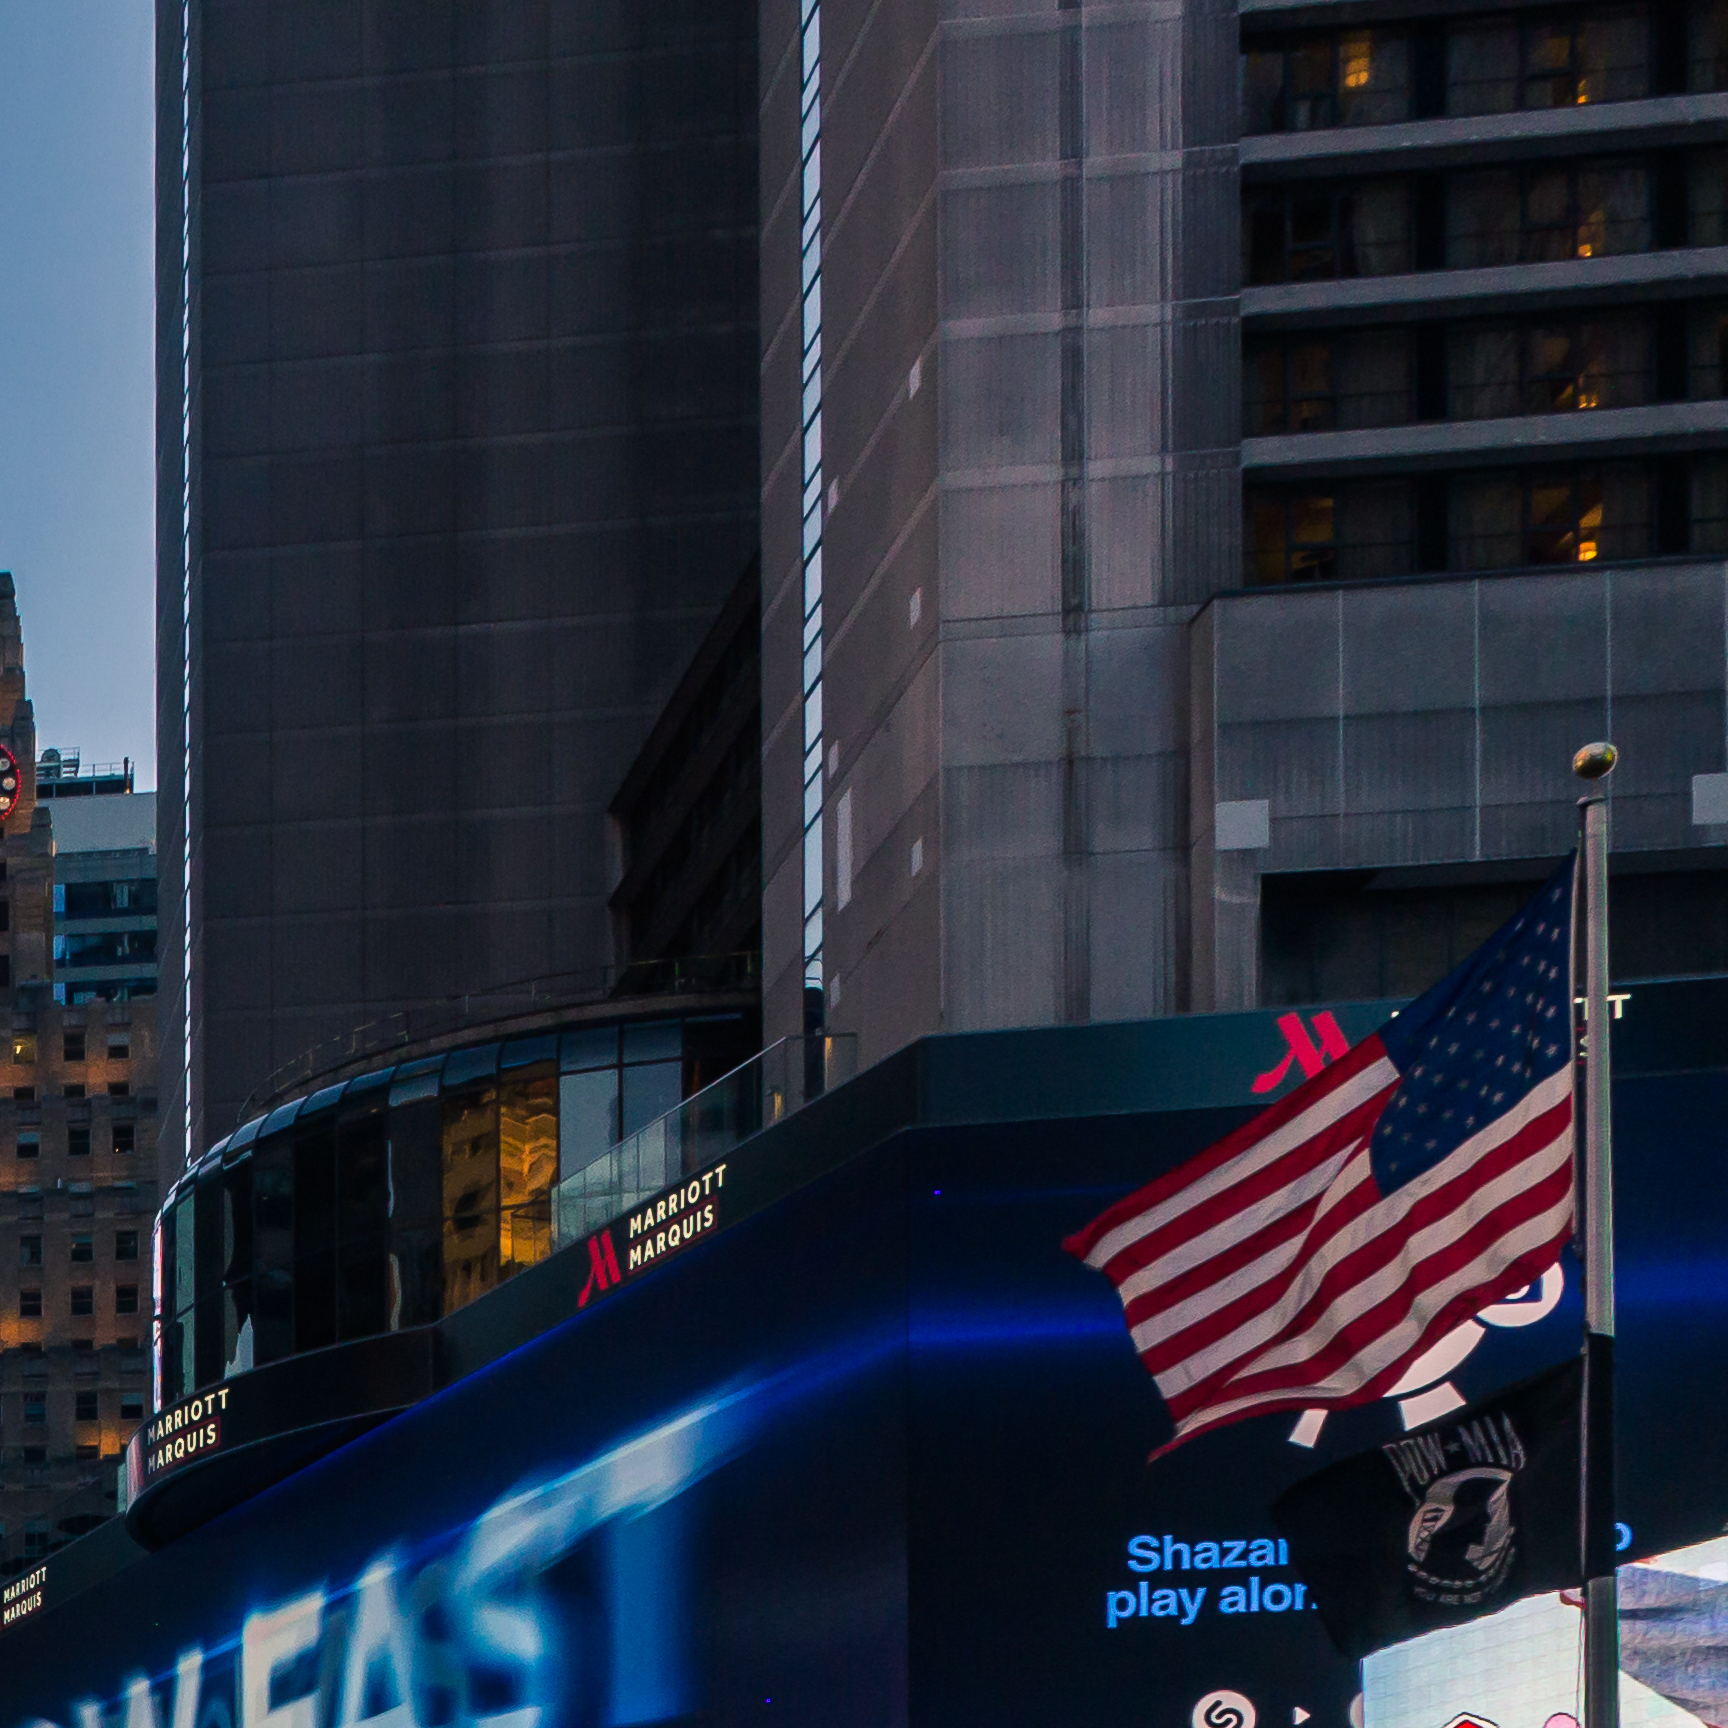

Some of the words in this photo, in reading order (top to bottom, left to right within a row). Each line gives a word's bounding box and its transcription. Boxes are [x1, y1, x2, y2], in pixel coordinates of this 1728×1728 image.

[628, 1164, 727, 1239] MARRIOTT
[628, 1205, 716, 1270] MARQUIS
[147, 1389, 230, 1445] MARRIOTT
[147, 1423, 218, 1474] MARQUIS
[1383, 1433, 1445, 1492] POW
[1459, 1411, 1526, 1470] MIA
[3, 1567, 48, 1604] MARRIOTT
[3, 1591, 43, 1624] MARQUIS
[1106, 1581, 1208, 1628] play
